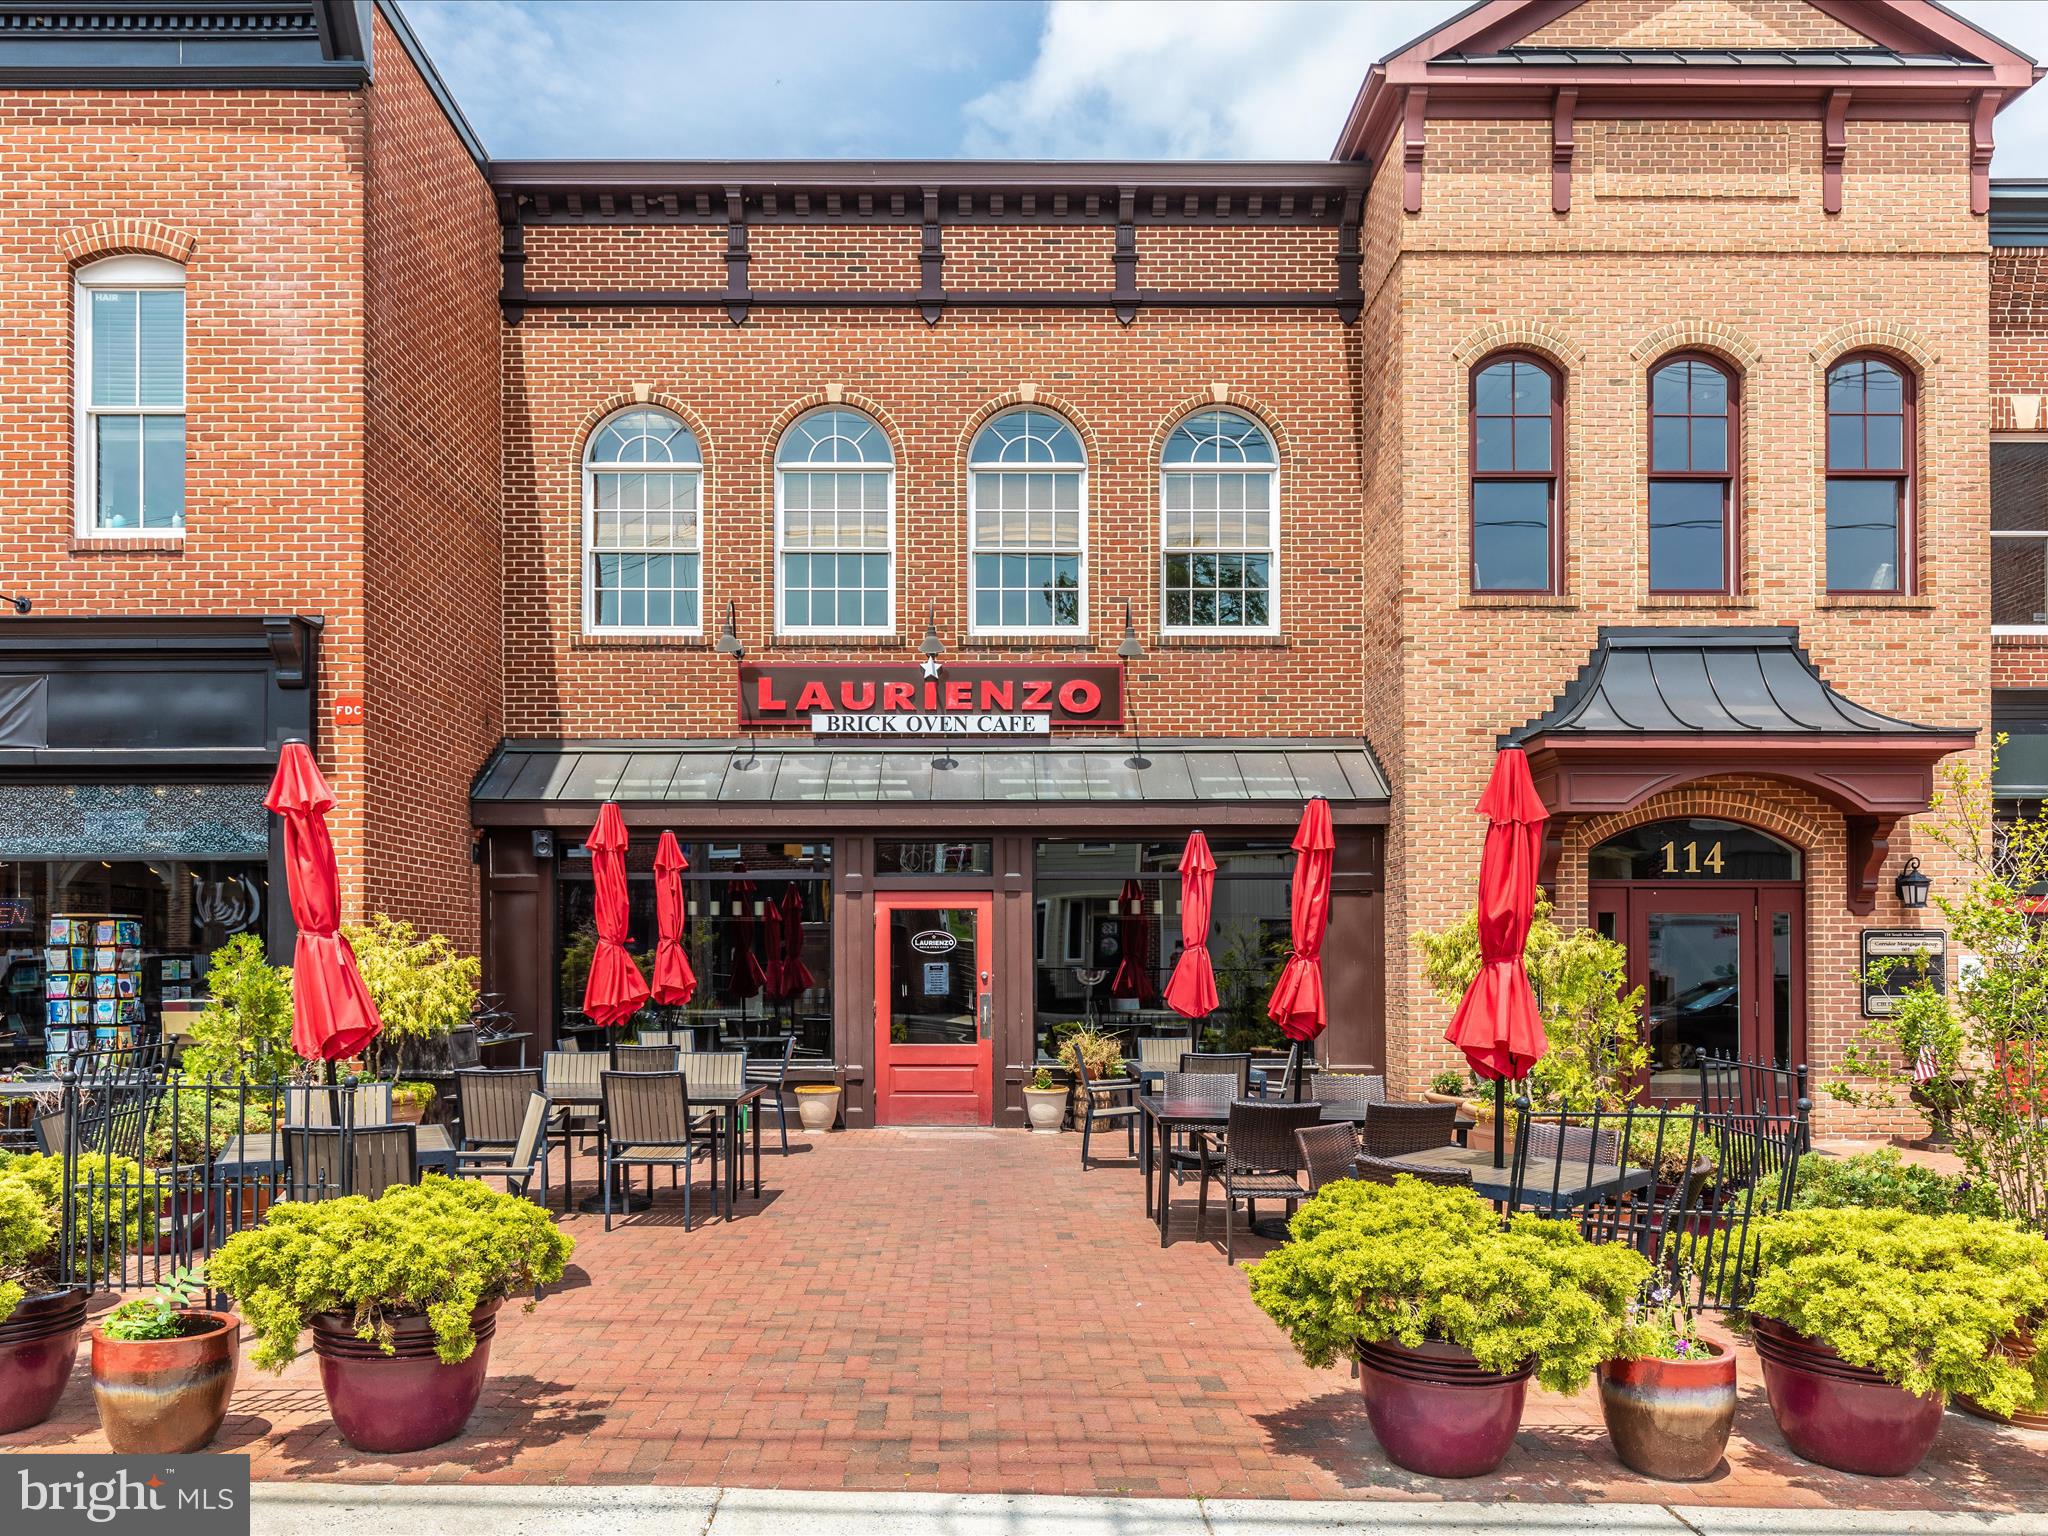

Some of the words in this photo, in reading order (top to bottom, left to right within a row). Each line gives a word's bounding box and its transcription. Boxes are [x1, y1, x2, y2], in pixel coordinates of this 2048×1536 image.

[95, 293, 119, 302] HAIR
[758, 676, 1102, 714] LAURIENZO
[336, 705, 362, 716] FDC
[827, 715, 898, 732] BRICK
[906, 715, 969, 732] OVEN
[977, 715, 1036, 732] CAFE
[1660, 841, 1725, 874] 114
